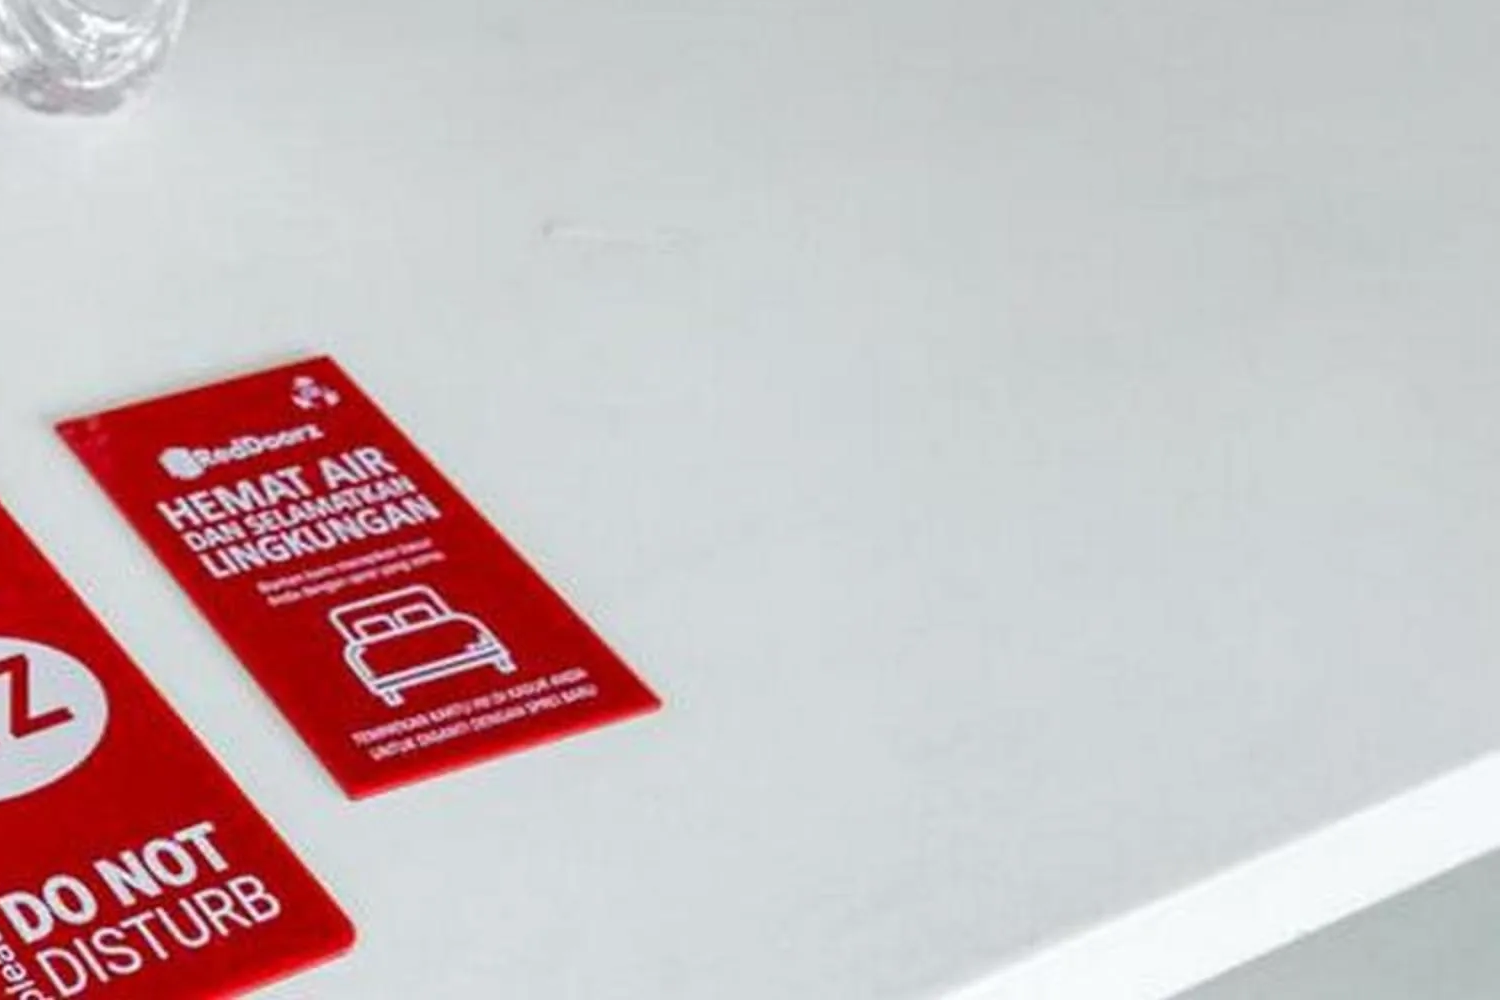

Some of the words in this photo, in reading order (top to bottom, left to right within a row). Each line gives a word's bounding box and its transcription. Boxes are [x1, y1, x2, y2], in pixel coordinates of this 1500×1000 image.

[157, 466, 310, 530] HEMAT
[319, 447, 397, 488] AIR
[182, 520, 245, 551] DAN
[243, 475, 417, 534] SELAMATKAN
[198, 495, 441, 578] LINGKUNGAN
[94, 821, 228, 905] NOT
[35, 874, 280, 997] DISTURB
